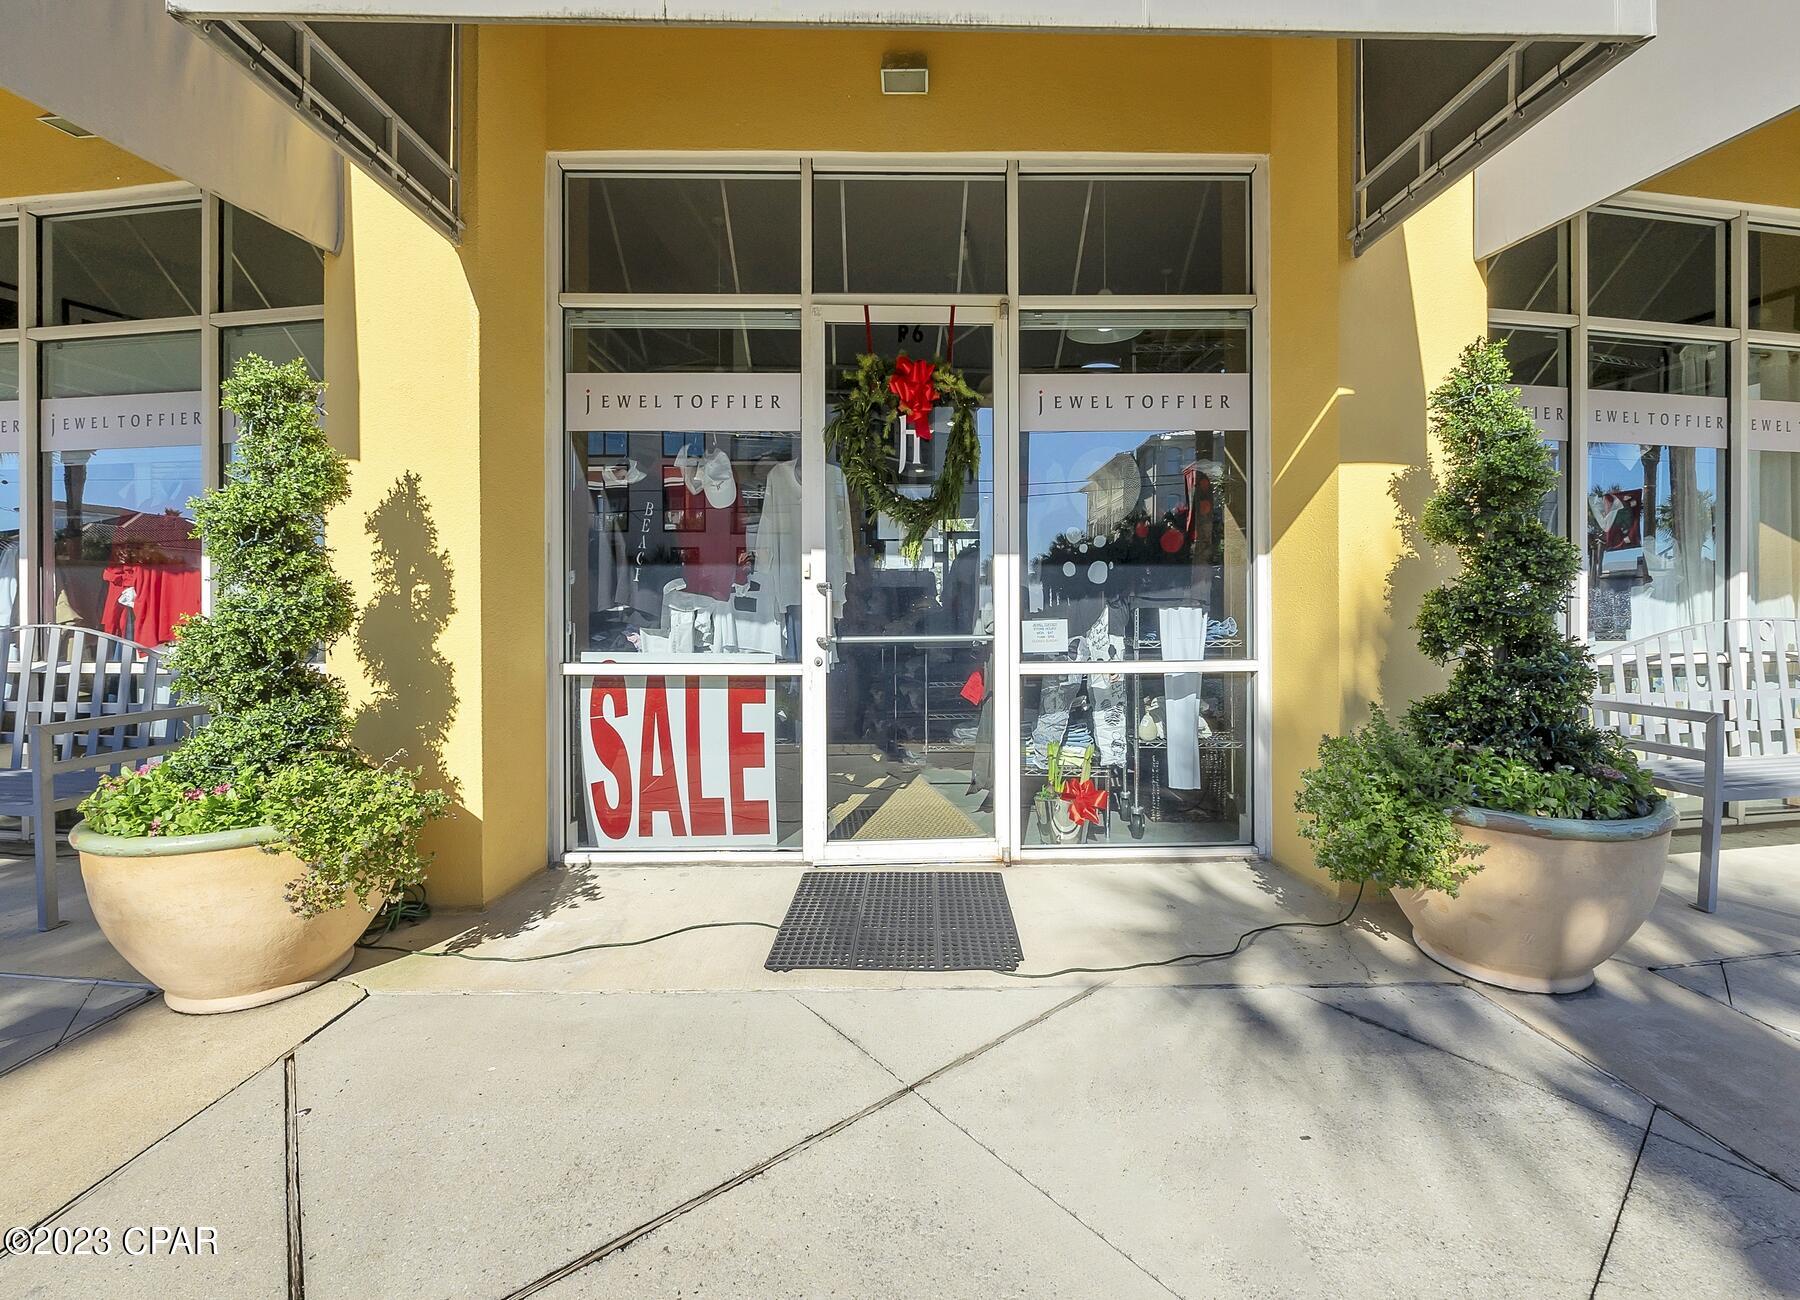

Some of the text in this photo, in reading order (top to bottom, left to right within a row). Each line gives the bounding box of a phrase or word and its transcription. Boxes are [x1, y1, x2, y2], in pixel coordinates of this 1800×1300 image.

[674, 394, 782, 409] TOFFIER
[1125, 394, 1231, 409] TOFFIER
[118, 411, 202, 429] TOFFIER
[1647, 411, 1724, 429] TOFFIER
[589, 660, 771, 840] SALE
